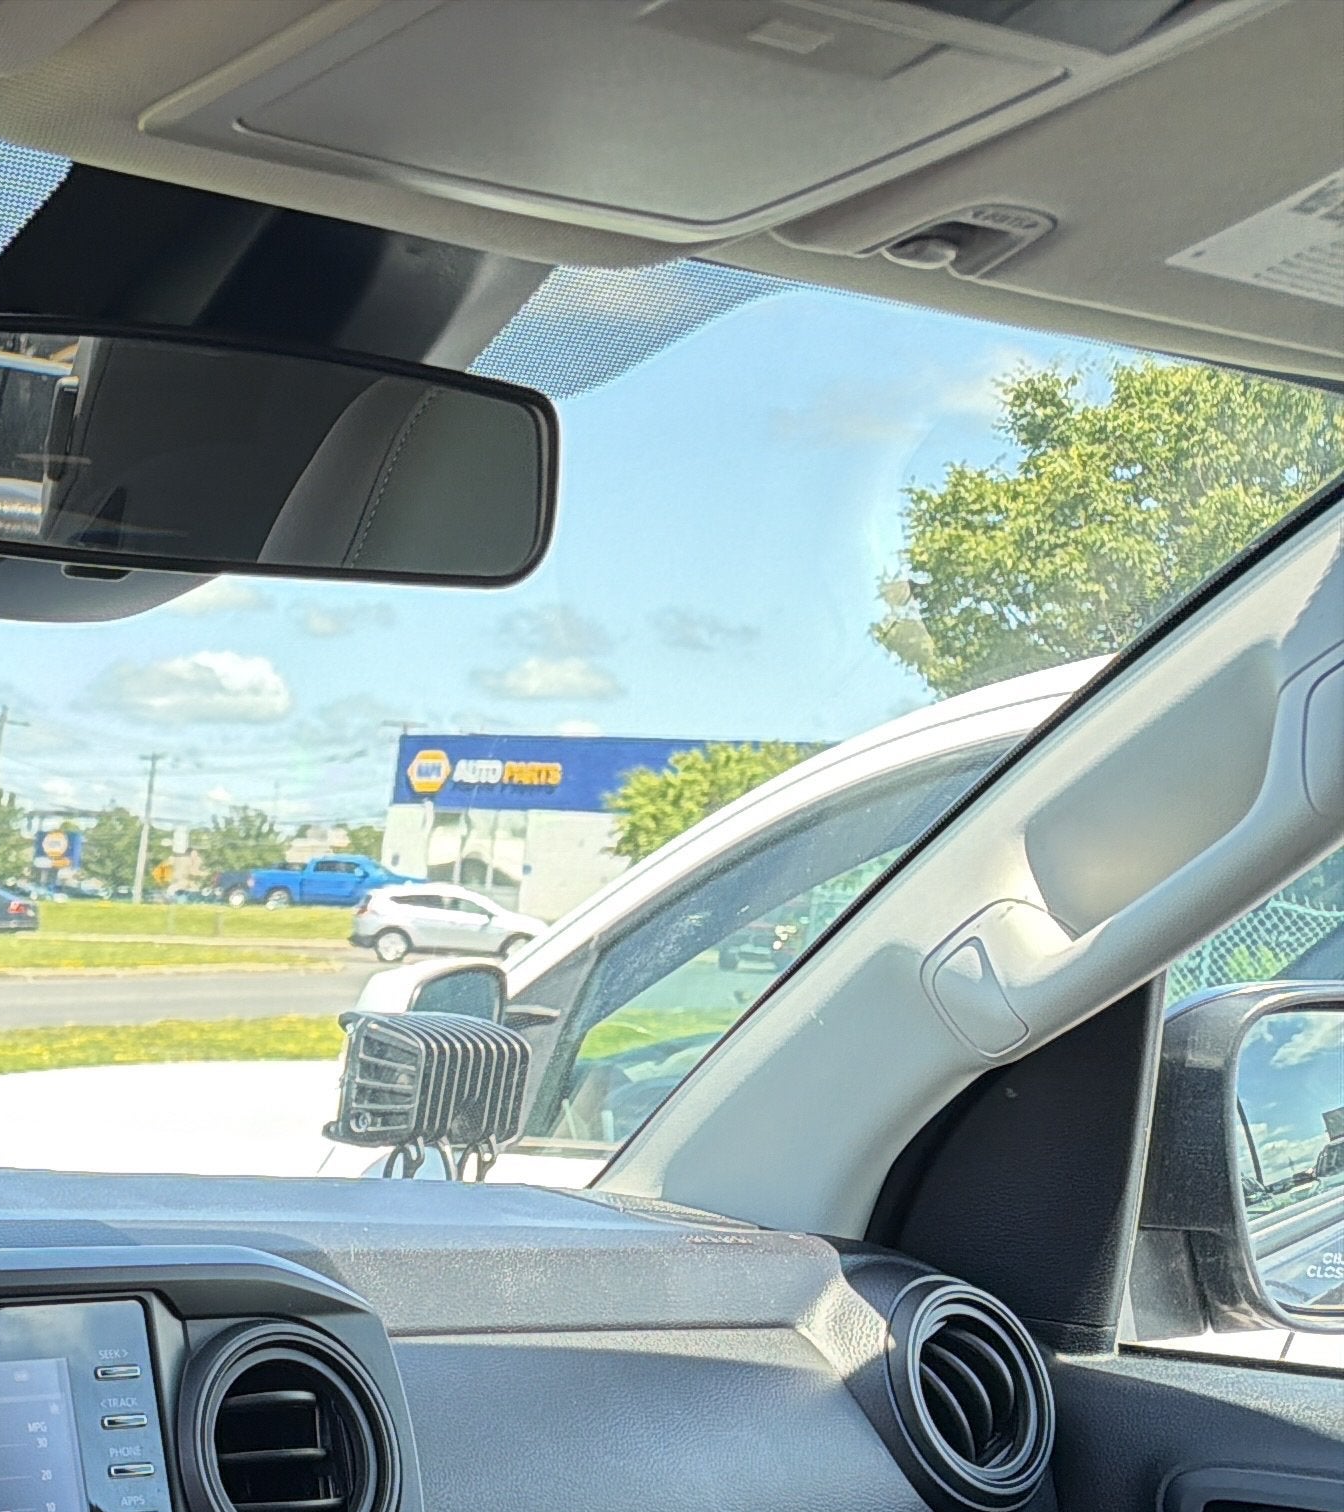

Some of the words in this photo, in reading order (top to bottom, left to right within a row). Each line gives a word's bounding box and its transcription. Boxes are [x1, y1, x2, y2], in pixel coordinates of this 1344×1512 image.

[36, 1437, 48, 1448] 30
[41, 1469, 52, 1480] 20
[46, 1502, 56, 1512] 10
